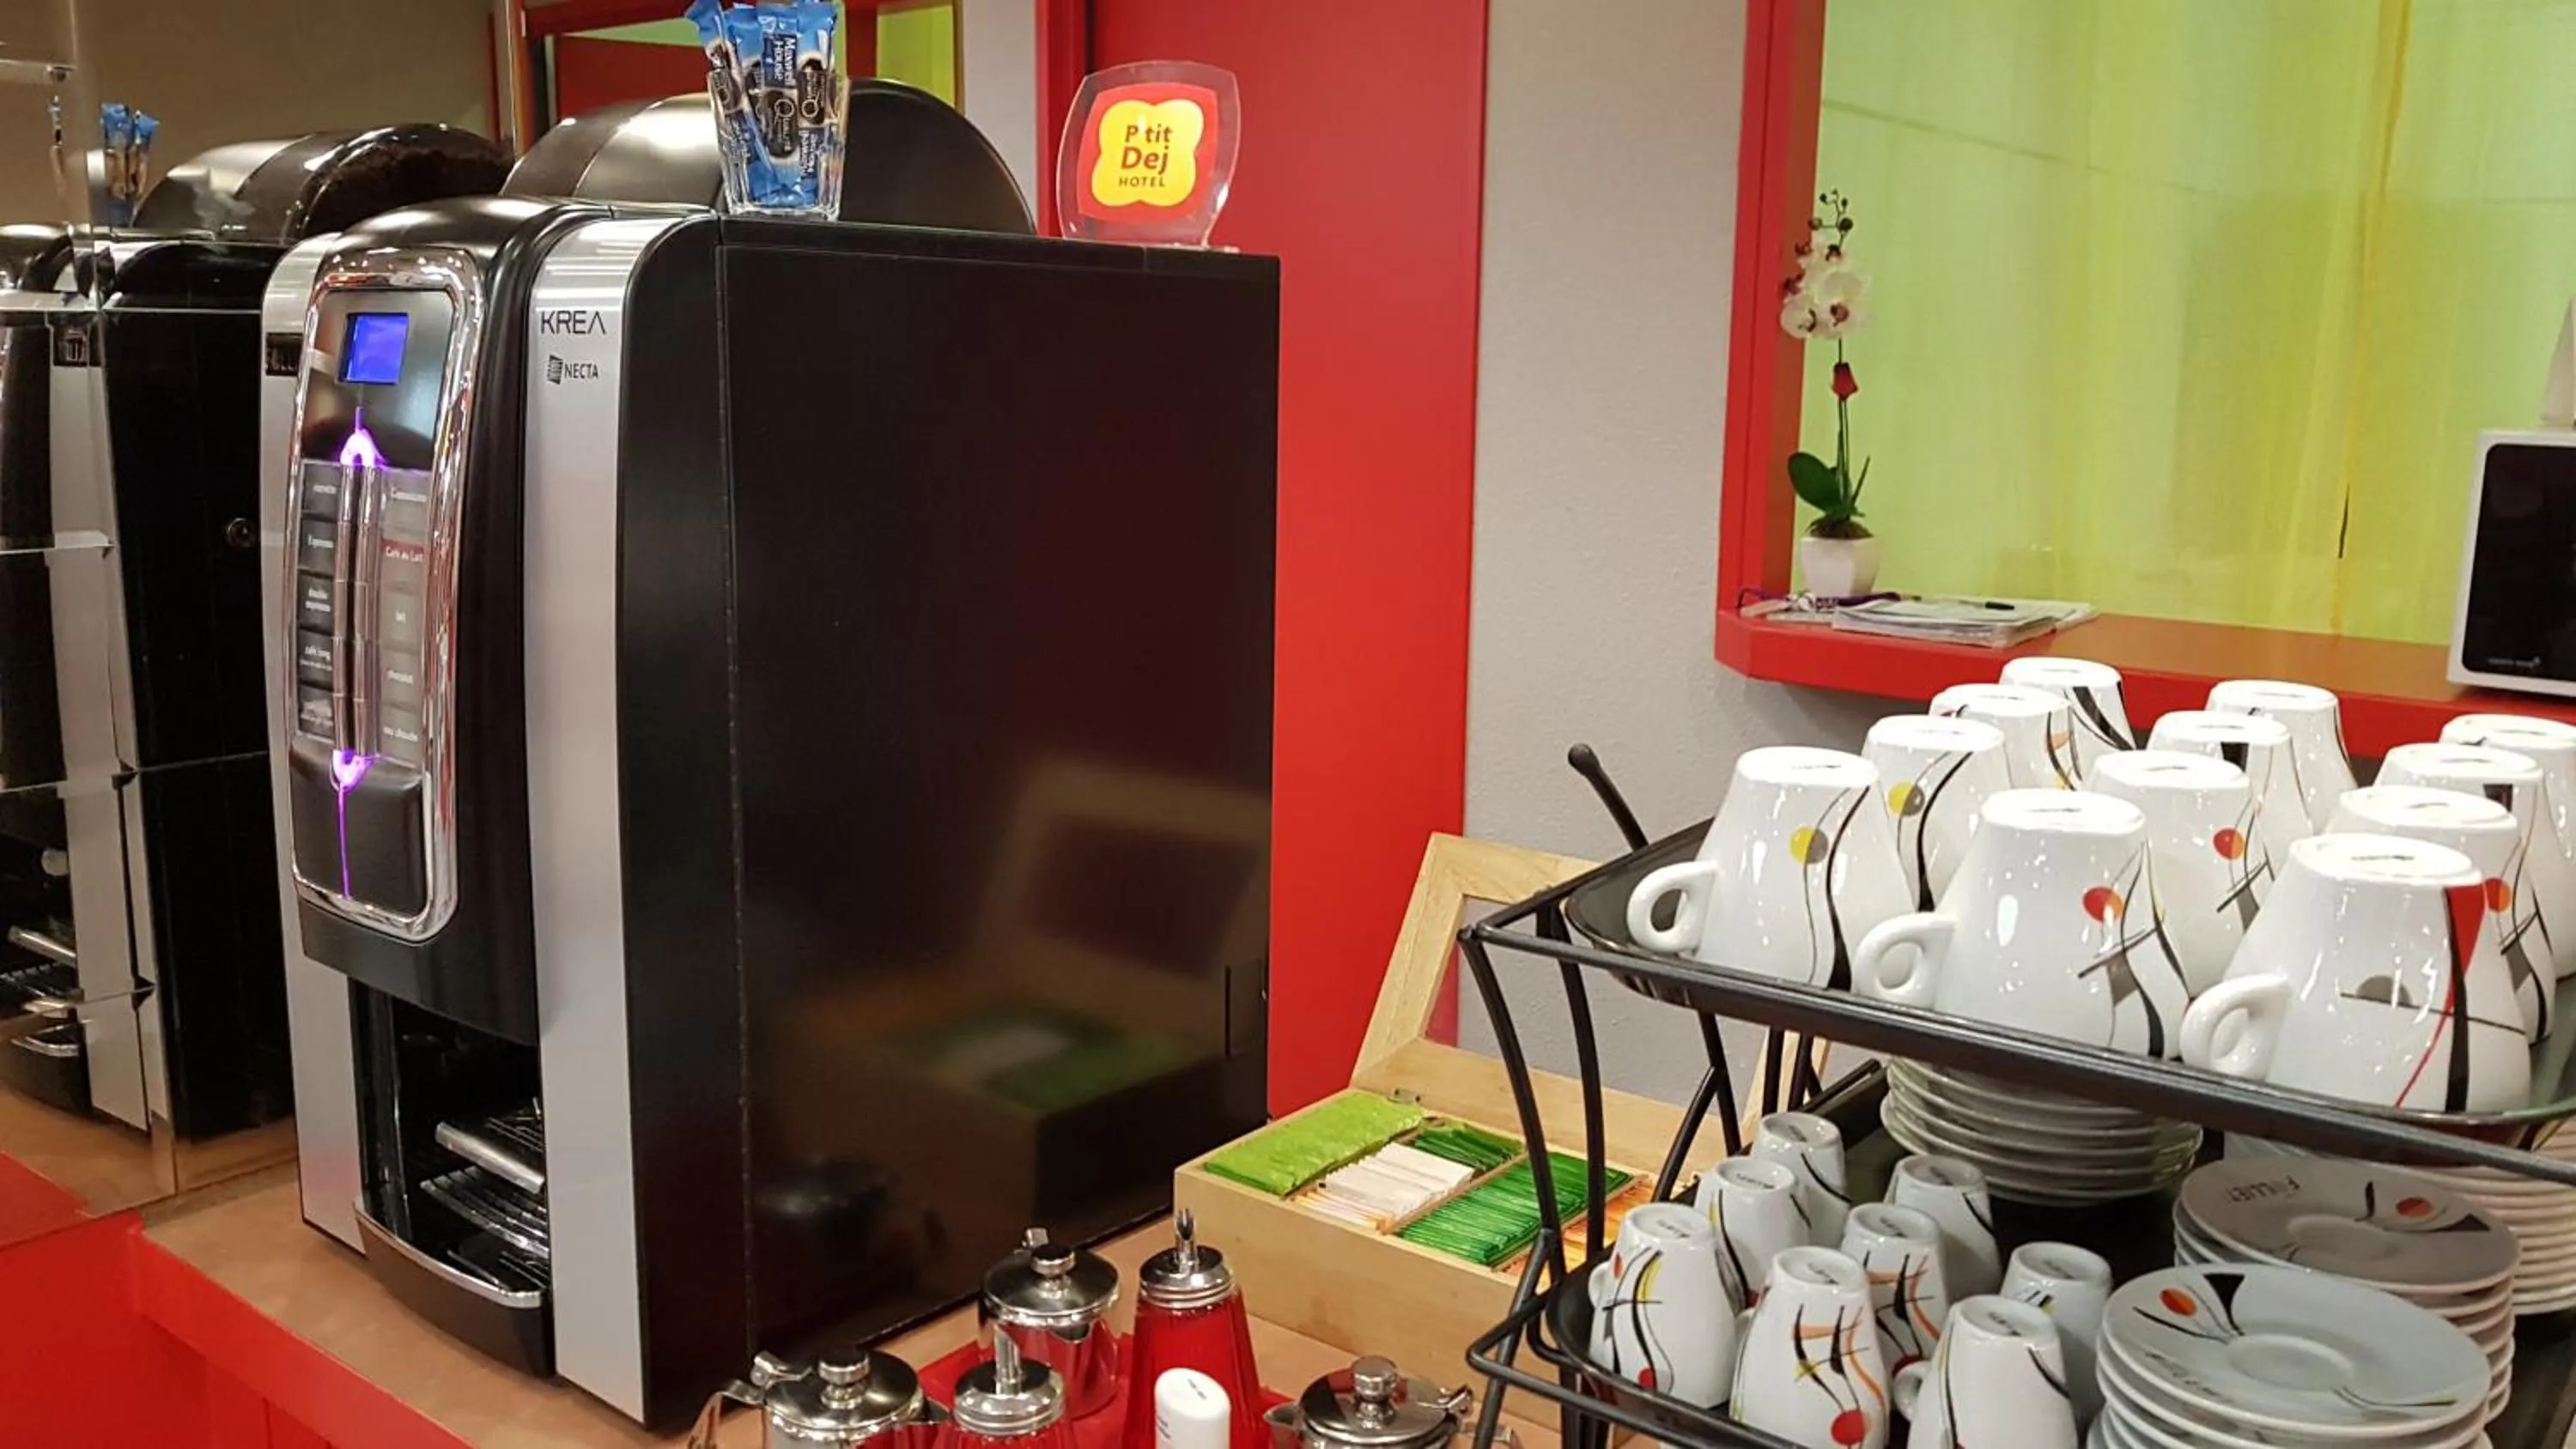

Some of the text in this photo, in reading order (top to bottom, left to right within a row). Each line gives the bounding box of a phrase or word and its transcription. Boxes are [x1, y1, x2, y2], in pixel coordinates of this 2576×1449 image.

[1121, 145, 1169, 175] Dej
[1118, 176, 1166, 187] HOTEL
[564, 363, 599, 379] NECTA
